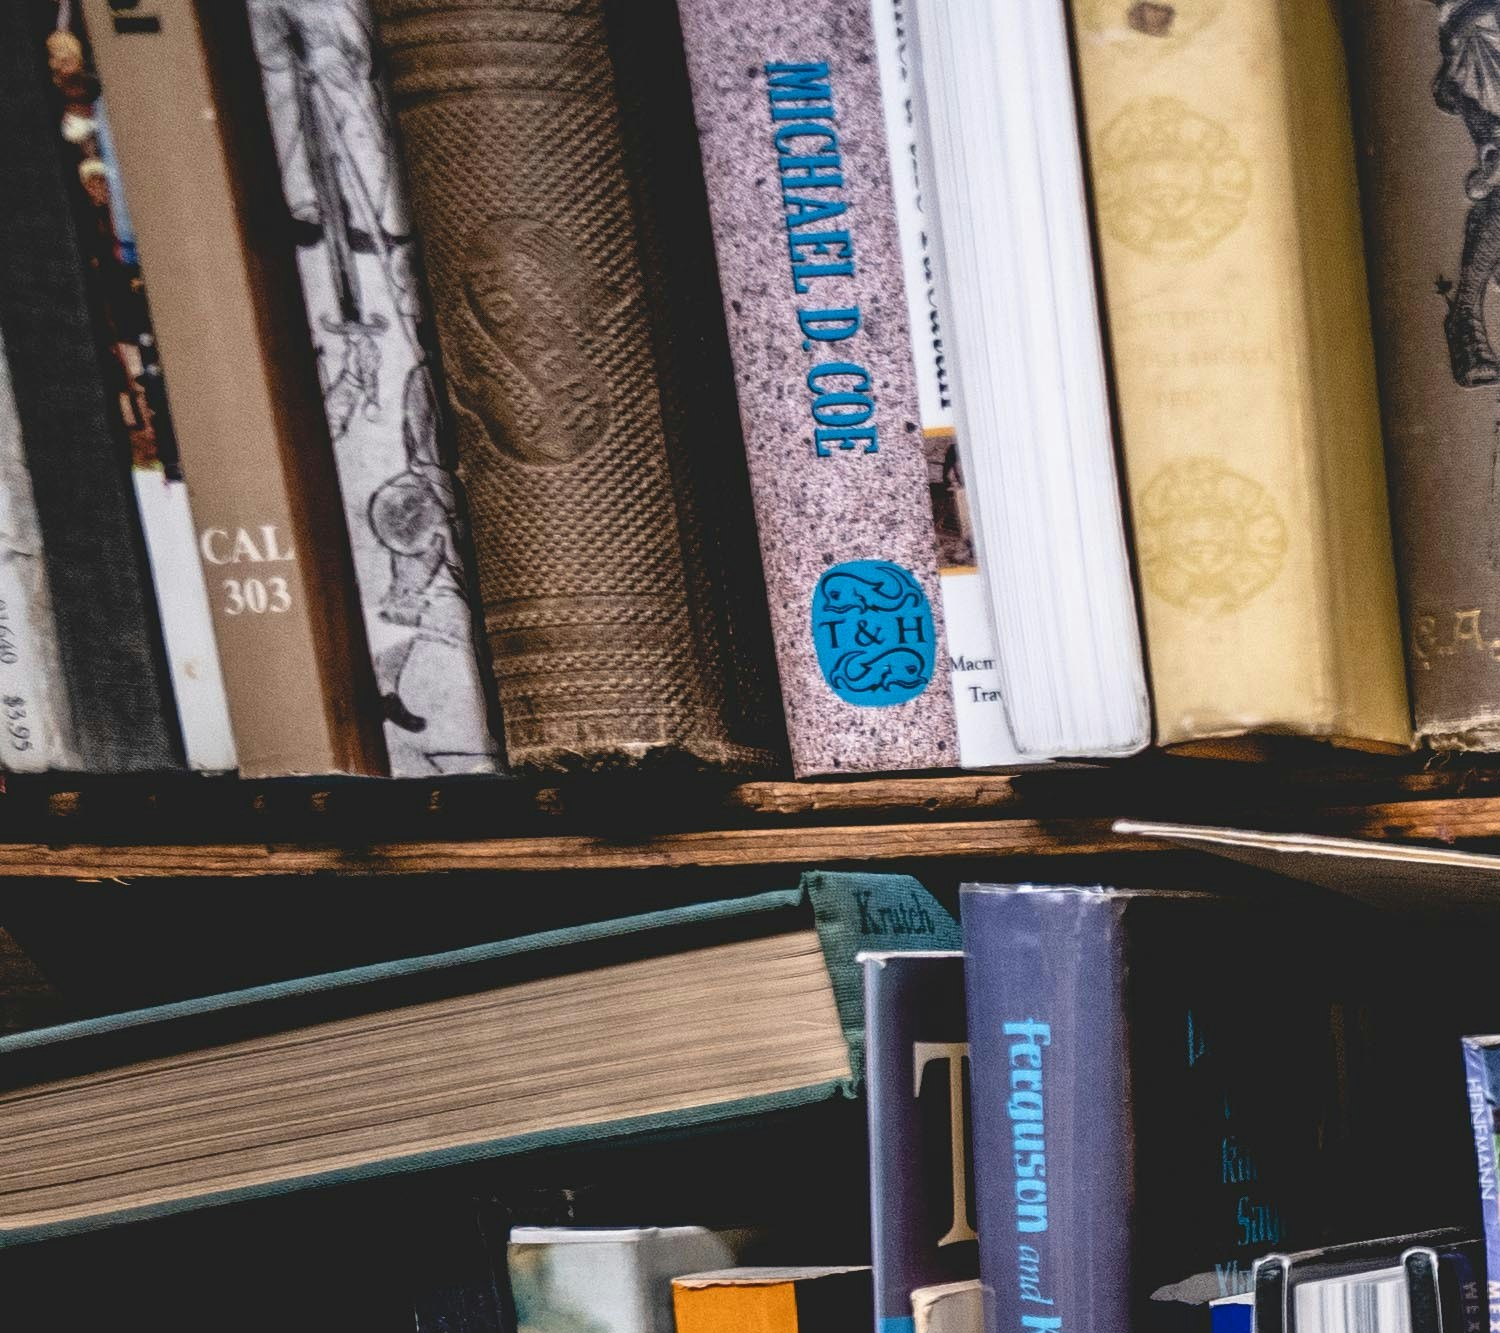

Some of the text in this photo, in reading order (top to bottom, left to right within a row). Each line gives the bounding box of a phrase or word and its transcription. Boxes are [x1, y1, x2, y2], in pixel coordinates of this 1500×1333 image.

[765, 60, 878, 459] MICHAEL D. COE
[202, 527, 295, 565] CAL
[223, 578, 292, 613] 303
[1002, 1017, 1050, 1233] Ferguson
[1018, 1246, 1045, 1306] and
